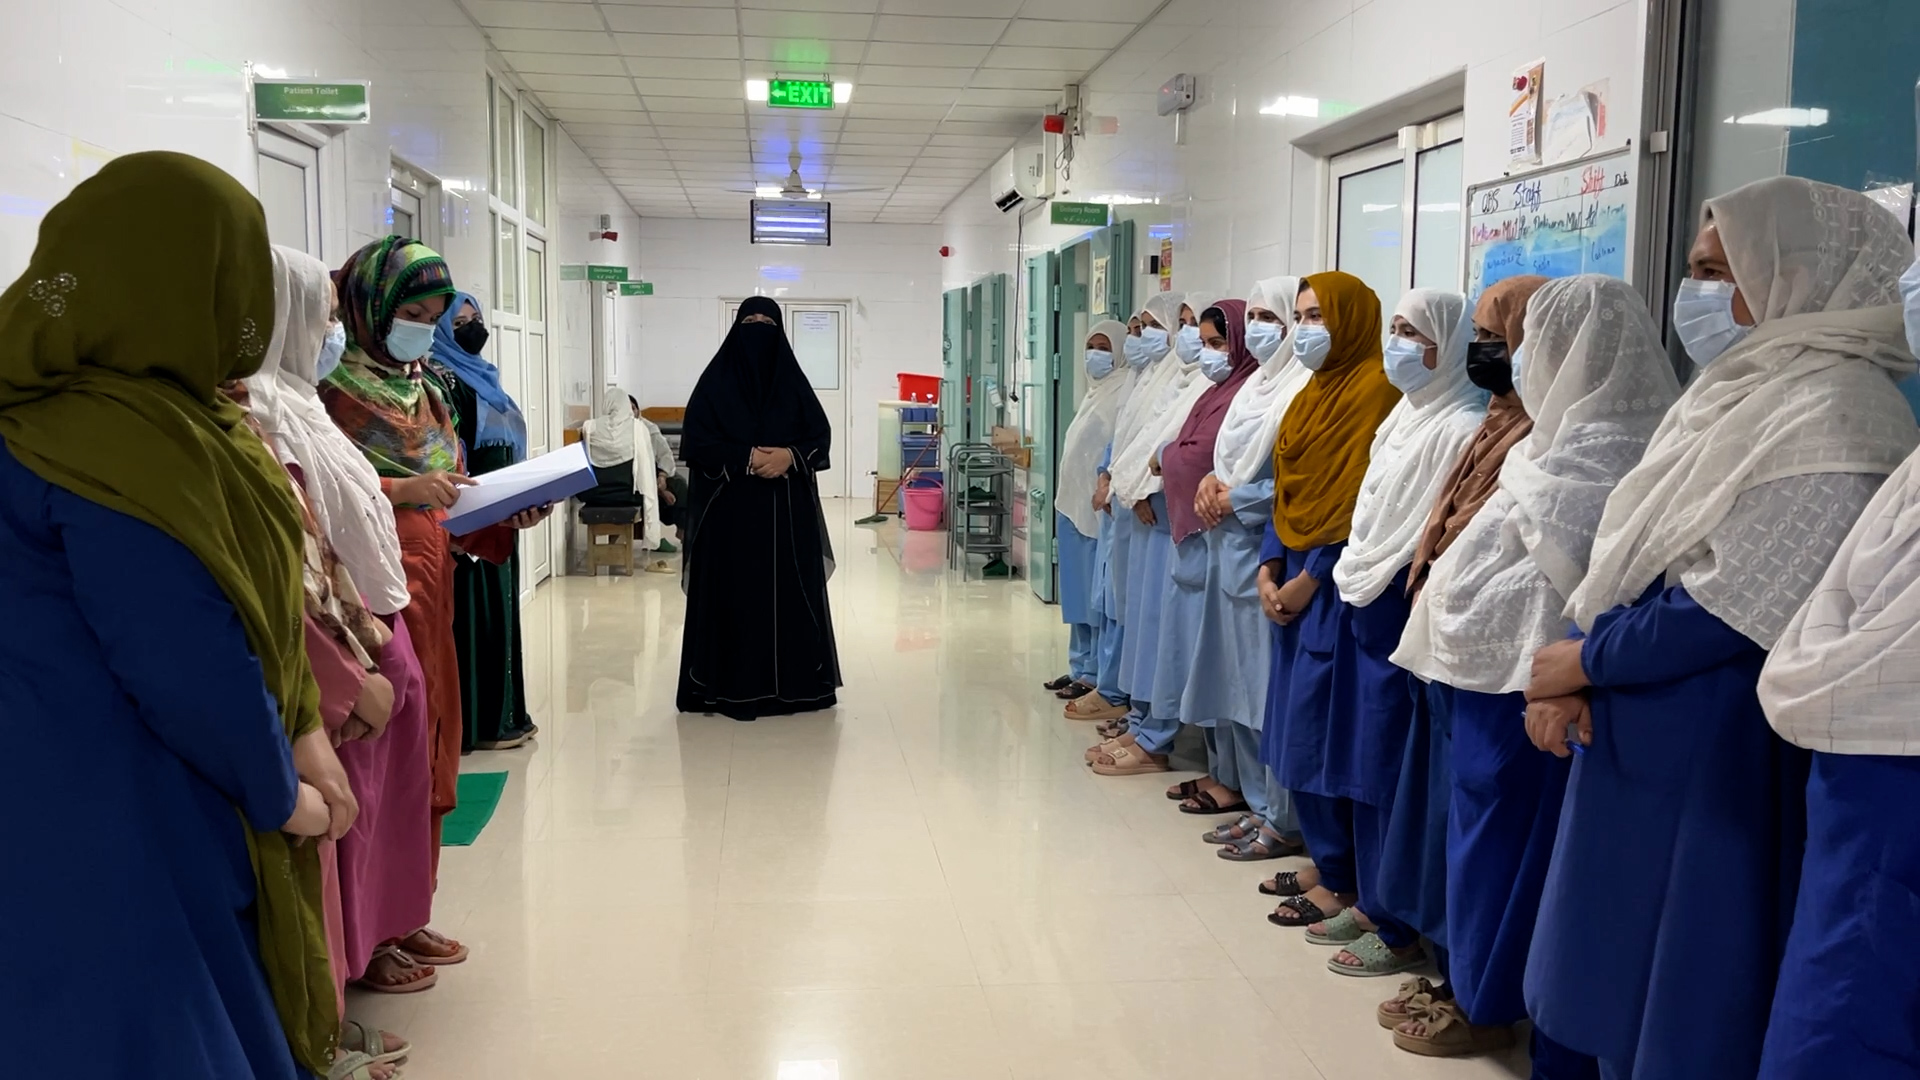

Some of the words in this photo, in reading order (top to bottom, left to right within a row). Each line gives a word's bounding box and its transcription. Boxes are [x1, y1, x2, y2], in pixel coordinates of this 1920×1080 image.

[283, 86, 314, 95] Patient
[315, 87, 339, 96] Toilet
[788, 85, 831, 104] EXIT
[1580, 165, 1605, 199] Shift
[1512, 179, 1542, 214] Staff
